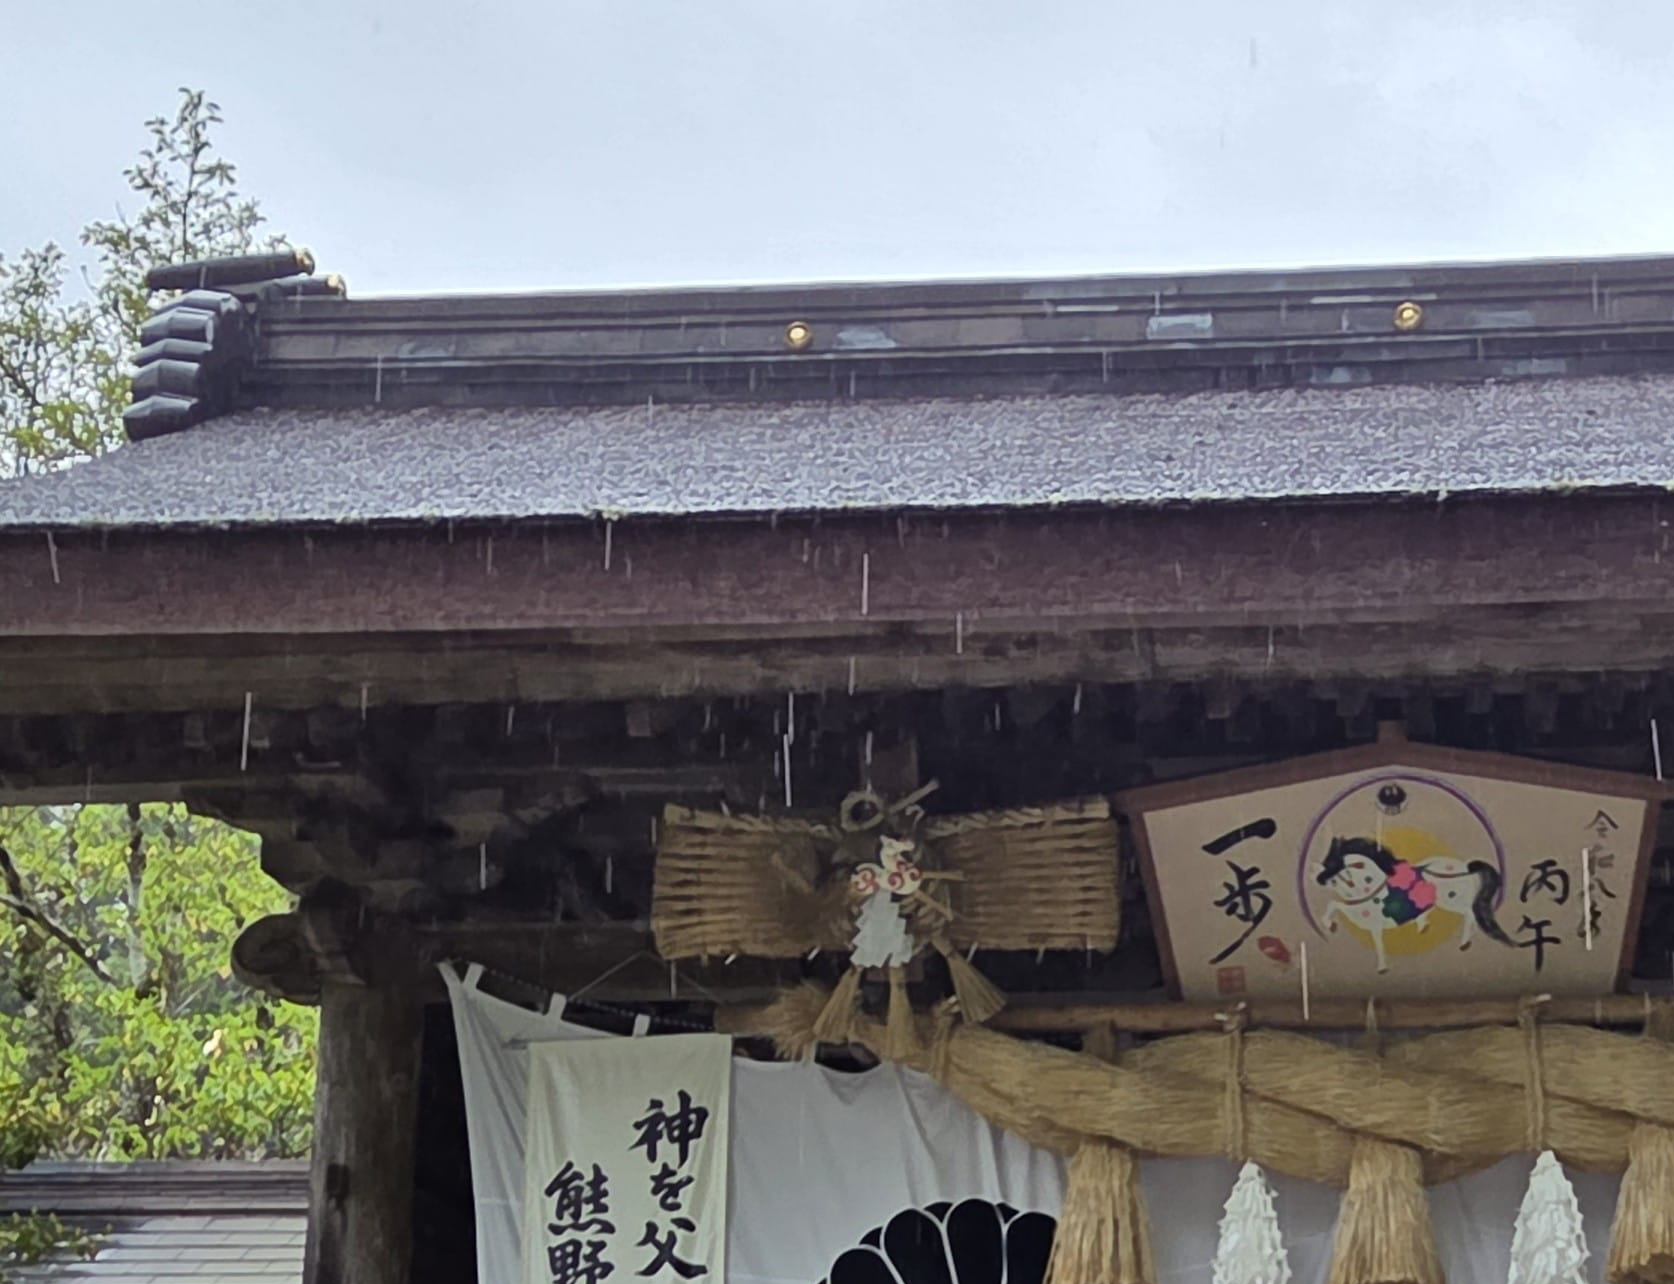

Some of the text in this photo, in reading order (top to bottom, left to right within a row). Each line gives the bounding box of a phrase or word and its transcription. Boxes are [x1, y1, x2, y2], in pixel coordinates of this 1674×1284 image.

[1202, 818, 1277, 964] 一歩
[629, 1090, 709, 1280] 神を父
